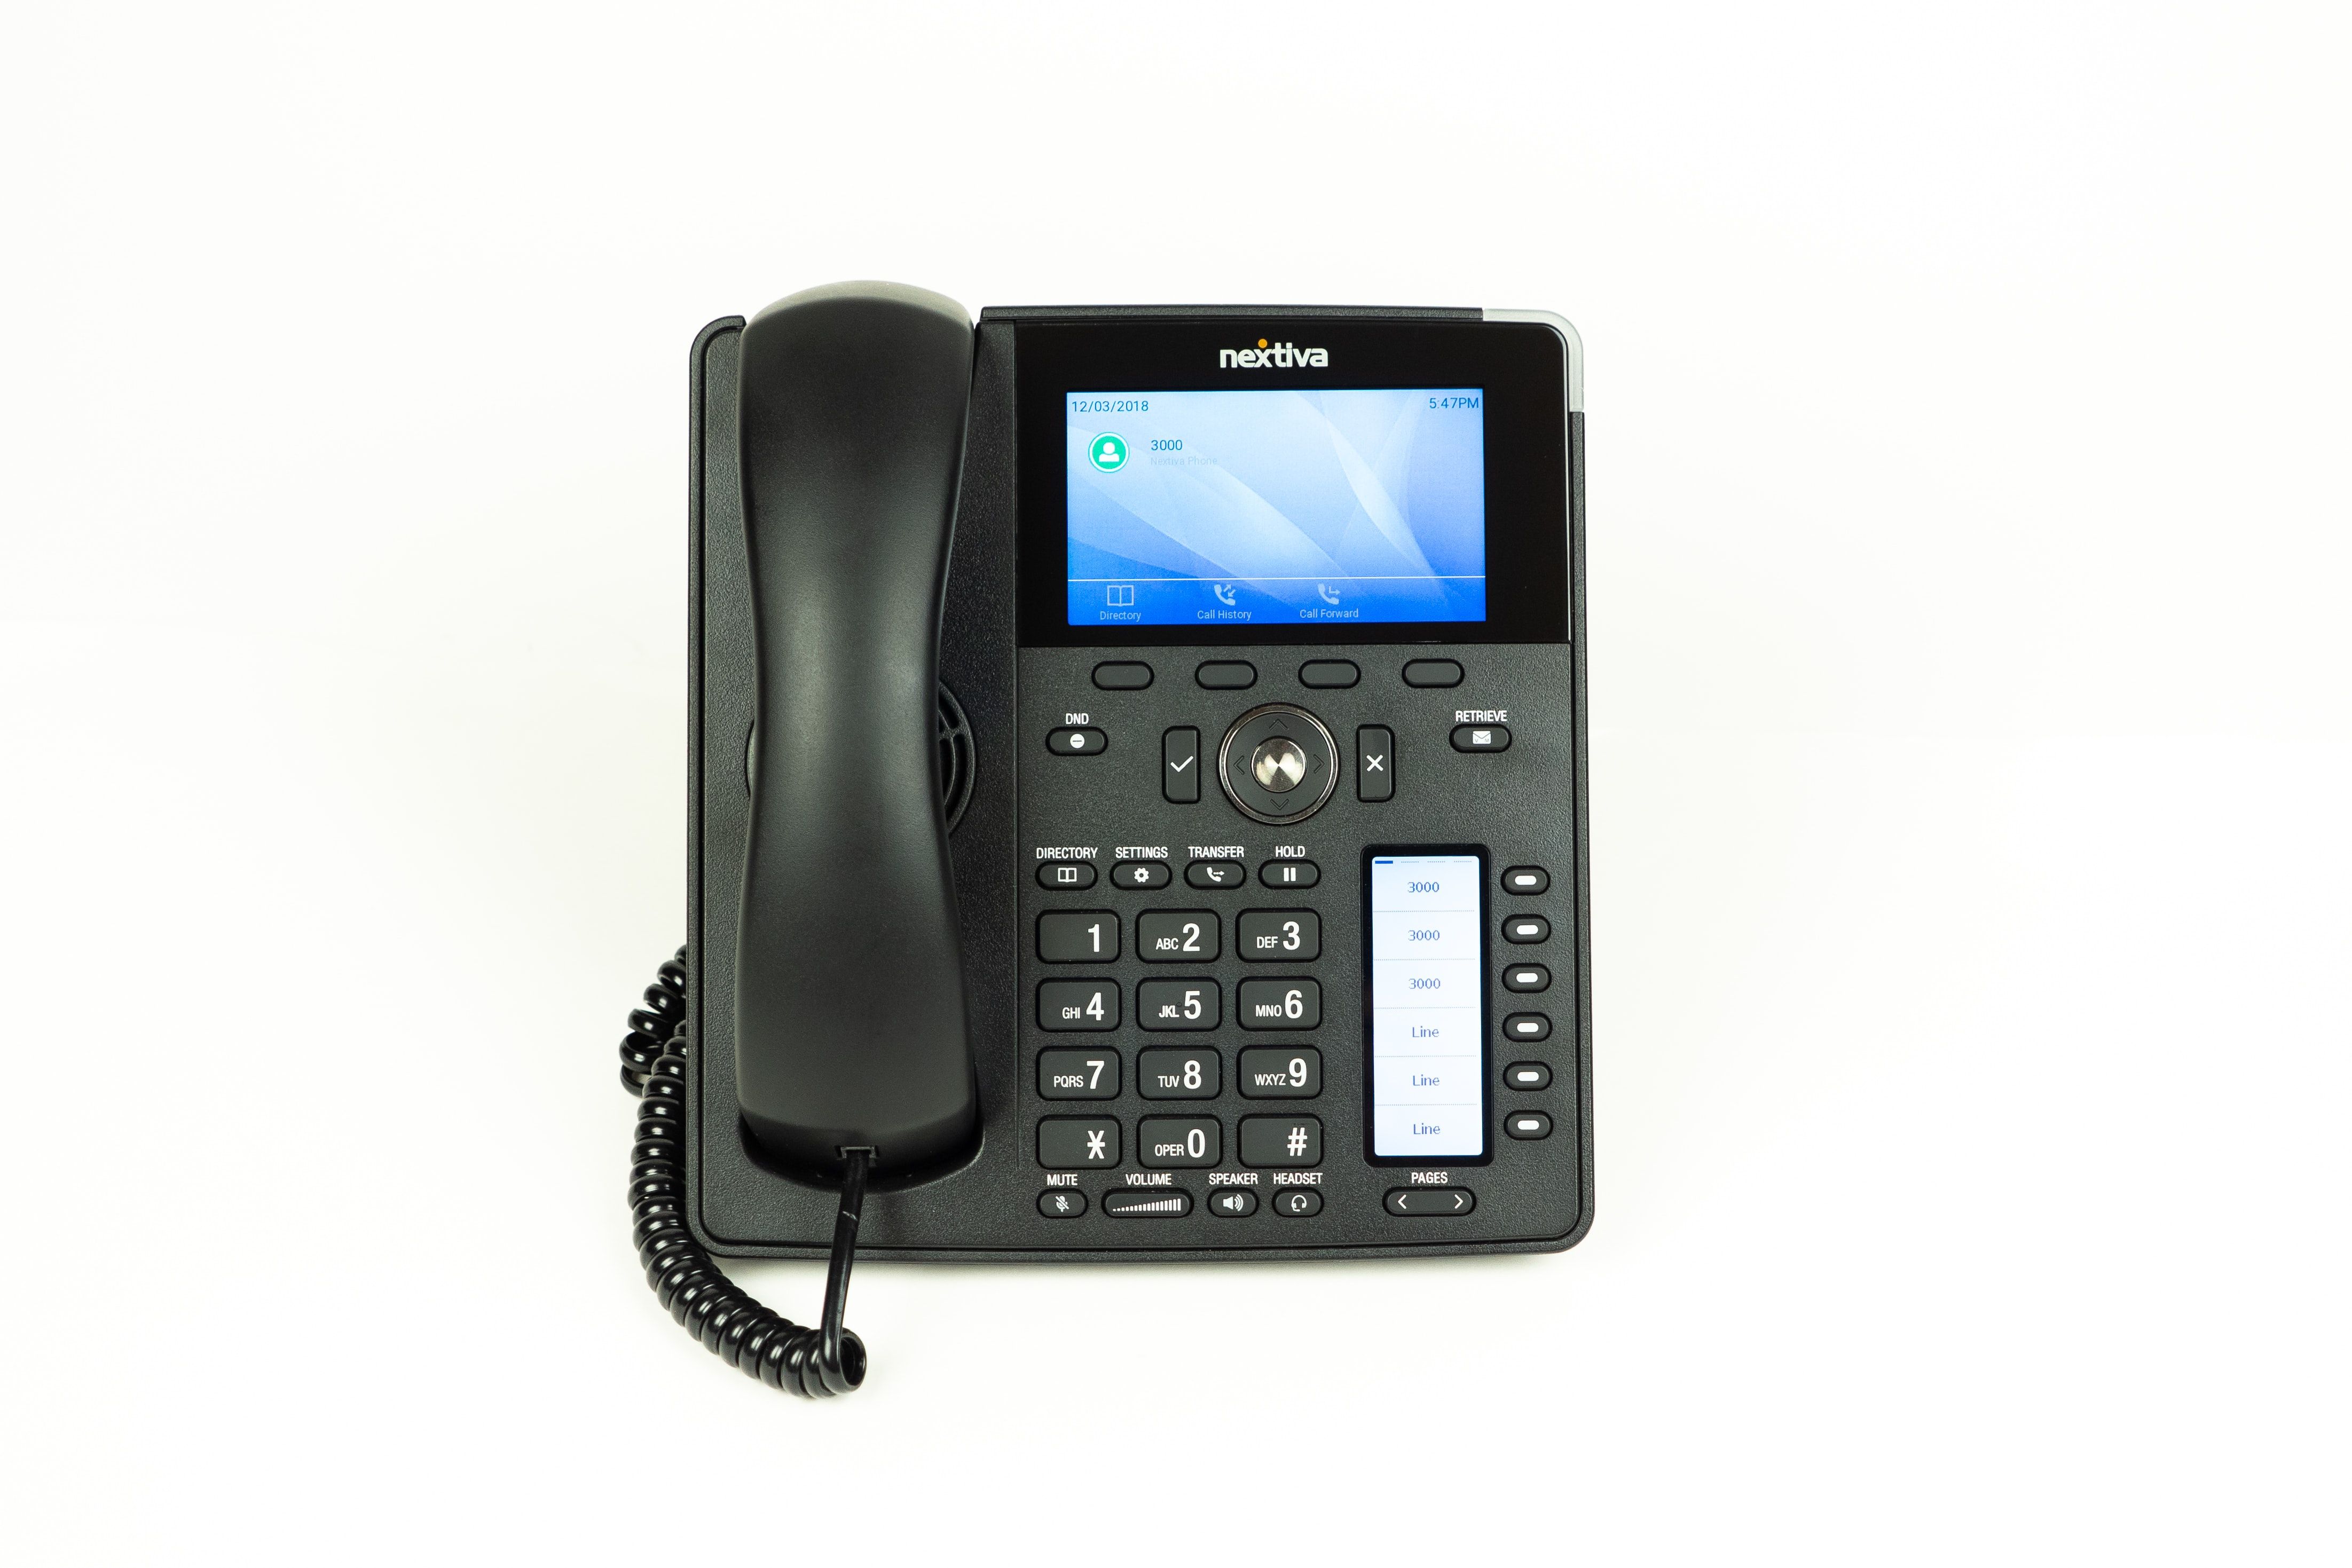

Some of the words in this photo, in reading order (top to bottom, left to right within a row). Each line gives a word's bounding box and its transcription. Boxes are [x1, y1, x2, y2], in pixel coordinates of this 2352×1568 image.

[1220, 338, 1328, 368] nextiva
[1072, 400, 1149, 413] 12/03/2018
[1429, 397, 1479, 409] 5:47PM
[1151, 439, 1183, 451] 3000
[1150, 456, 1185, 466] Nextiva
[1187, 456, 1218, 466] Phone
[1100, 611, 1142, 623] Directory
[1197, 609, 1215, 619] Call
[1218, 610, 1252, 621] History
[1300, 608, 1318, 618] Call
[1320, 608, 1359, 618] Forward
[1065, 713, 1089, 724] DND
[1455, 710, 1507, 722] RETRIEVE
[1036, 847, 1098, 859] DIRECTORY
[1115, 846, 1168, 858] SETTINGS
[1187, 846, 1245, 858] TRANSFER
[1275, 845, 1305, 857] HOLD
[1407, 881, 1439, 893] 3000
[1088, 924, 1100, 952] 1
[1155, 937, 1179, 950] ABC
[1182, 923, 1200, 952] 2
[1256, 936, 1278, 949] DEF
[1283, 921, 1300, 950] 3
[1408, 930, 1440, 941] 3000
[1409, 978, 1441, 989] 3000
[1062, 1007, 1081, 1019] GHI
[1086, 992, 1105, 1021] 4
[1158, 1005, 1180, 1018] JKL
[1184, 990, 1201, 1020] 5
[1255, 1004, 1282, 1017] MNO
[1285, 989, 1303, 1019] 6
[1412, 1026, 1439, 1038] Line
[1053, 1075, 1084, 1088] PQRS
[1087, 1060, 1105, 1090] 7
[1157, 1075, 1180, 1088] TUV
[1183, 1060, 1202, 1089] 8
[1254, 1073, 1286, 1086] WXYZ
[1288, 1058, 1307, 1087] 9
[1413, 1074, 1439, 1086] Line
[1413, 1122, 1441, 1134] Line
[1154, 1144, 1184, 1156] OPER
[1187, 1129, 1206, 1158] 0
[1047, 1173, 1078, 1186] MUTE
[1125, 1173, 1172, 1186] VOLUME
[1209, 1172, 1258, 1185] SPEAKER
[1273, 1172, 1323, 1185] HEADSET
[1411, 1171, 1448, 1184] PAGES
